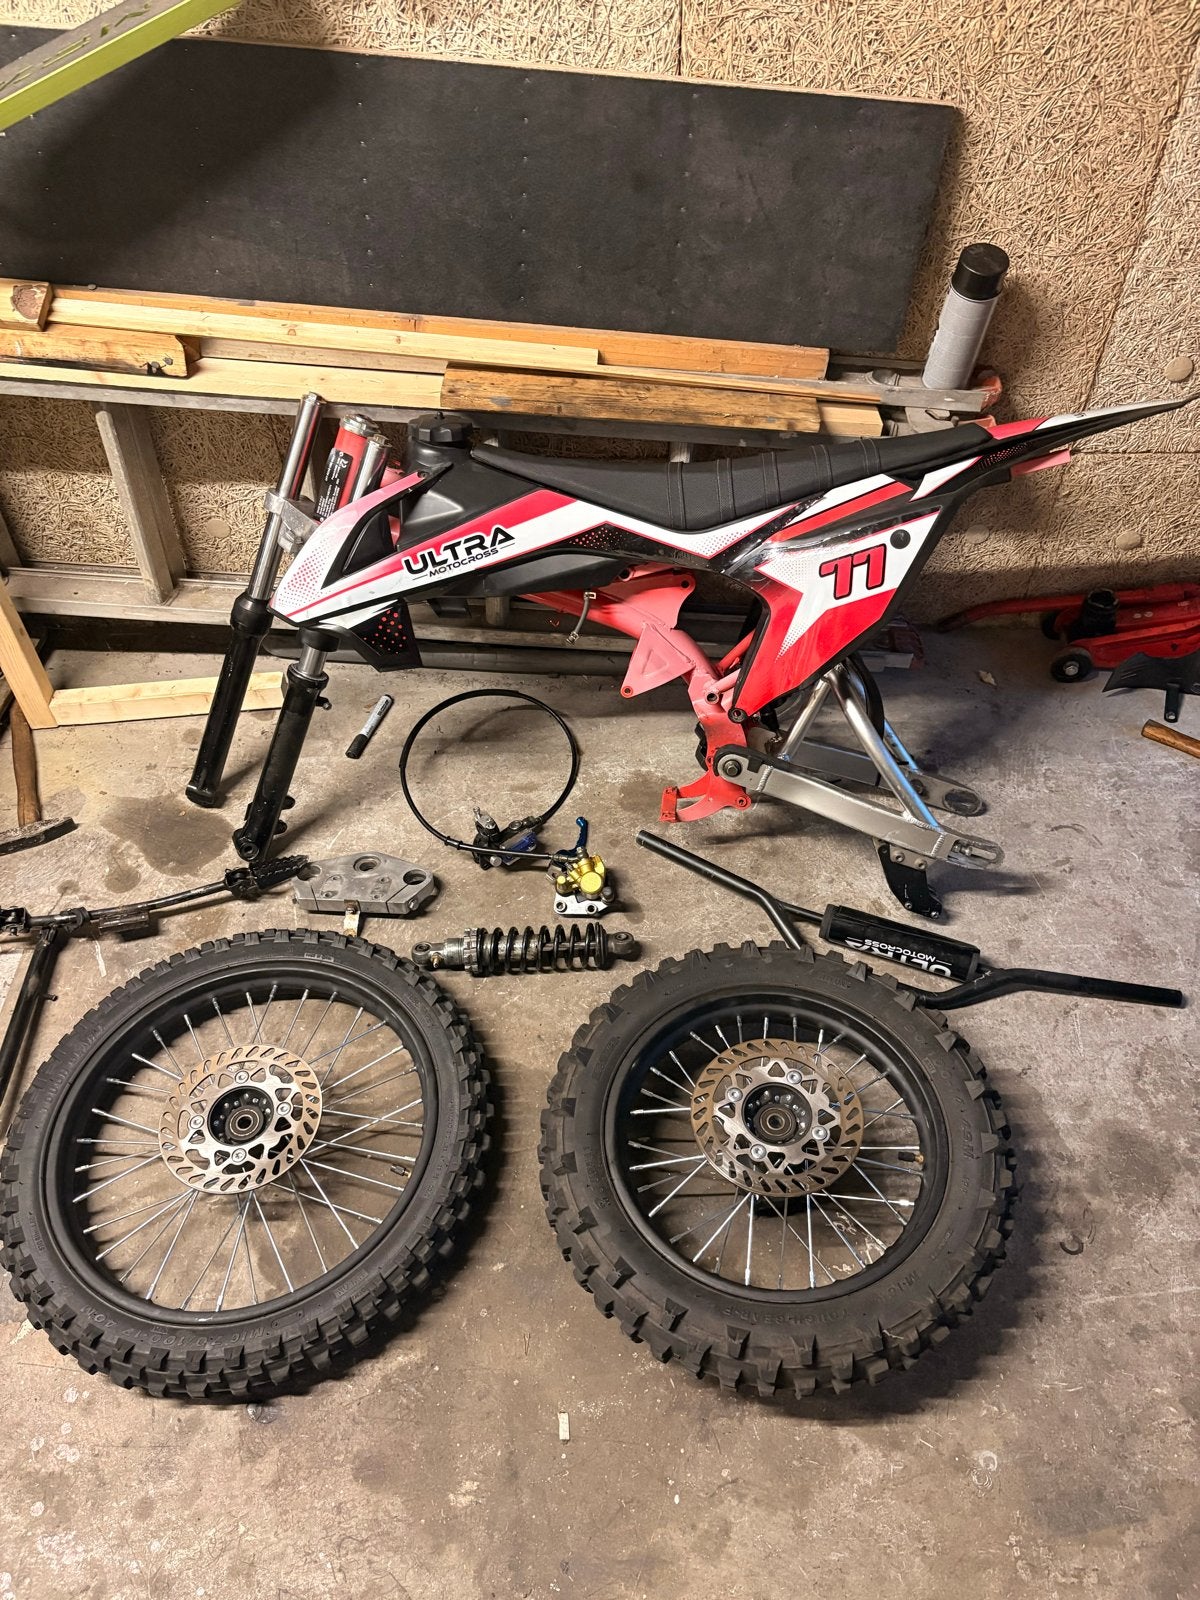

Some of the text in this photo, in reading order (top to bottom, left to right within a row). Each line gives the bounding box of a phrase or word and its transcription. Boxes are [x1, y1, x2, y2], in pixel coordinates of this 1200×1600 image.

[403, 526, 516, 575] ULTRA
[429, 547, 499, 578] MOTOCROSS
[819, 543, 887, 600] 77
[864, 939, 936, 963] MOTOCROSS
